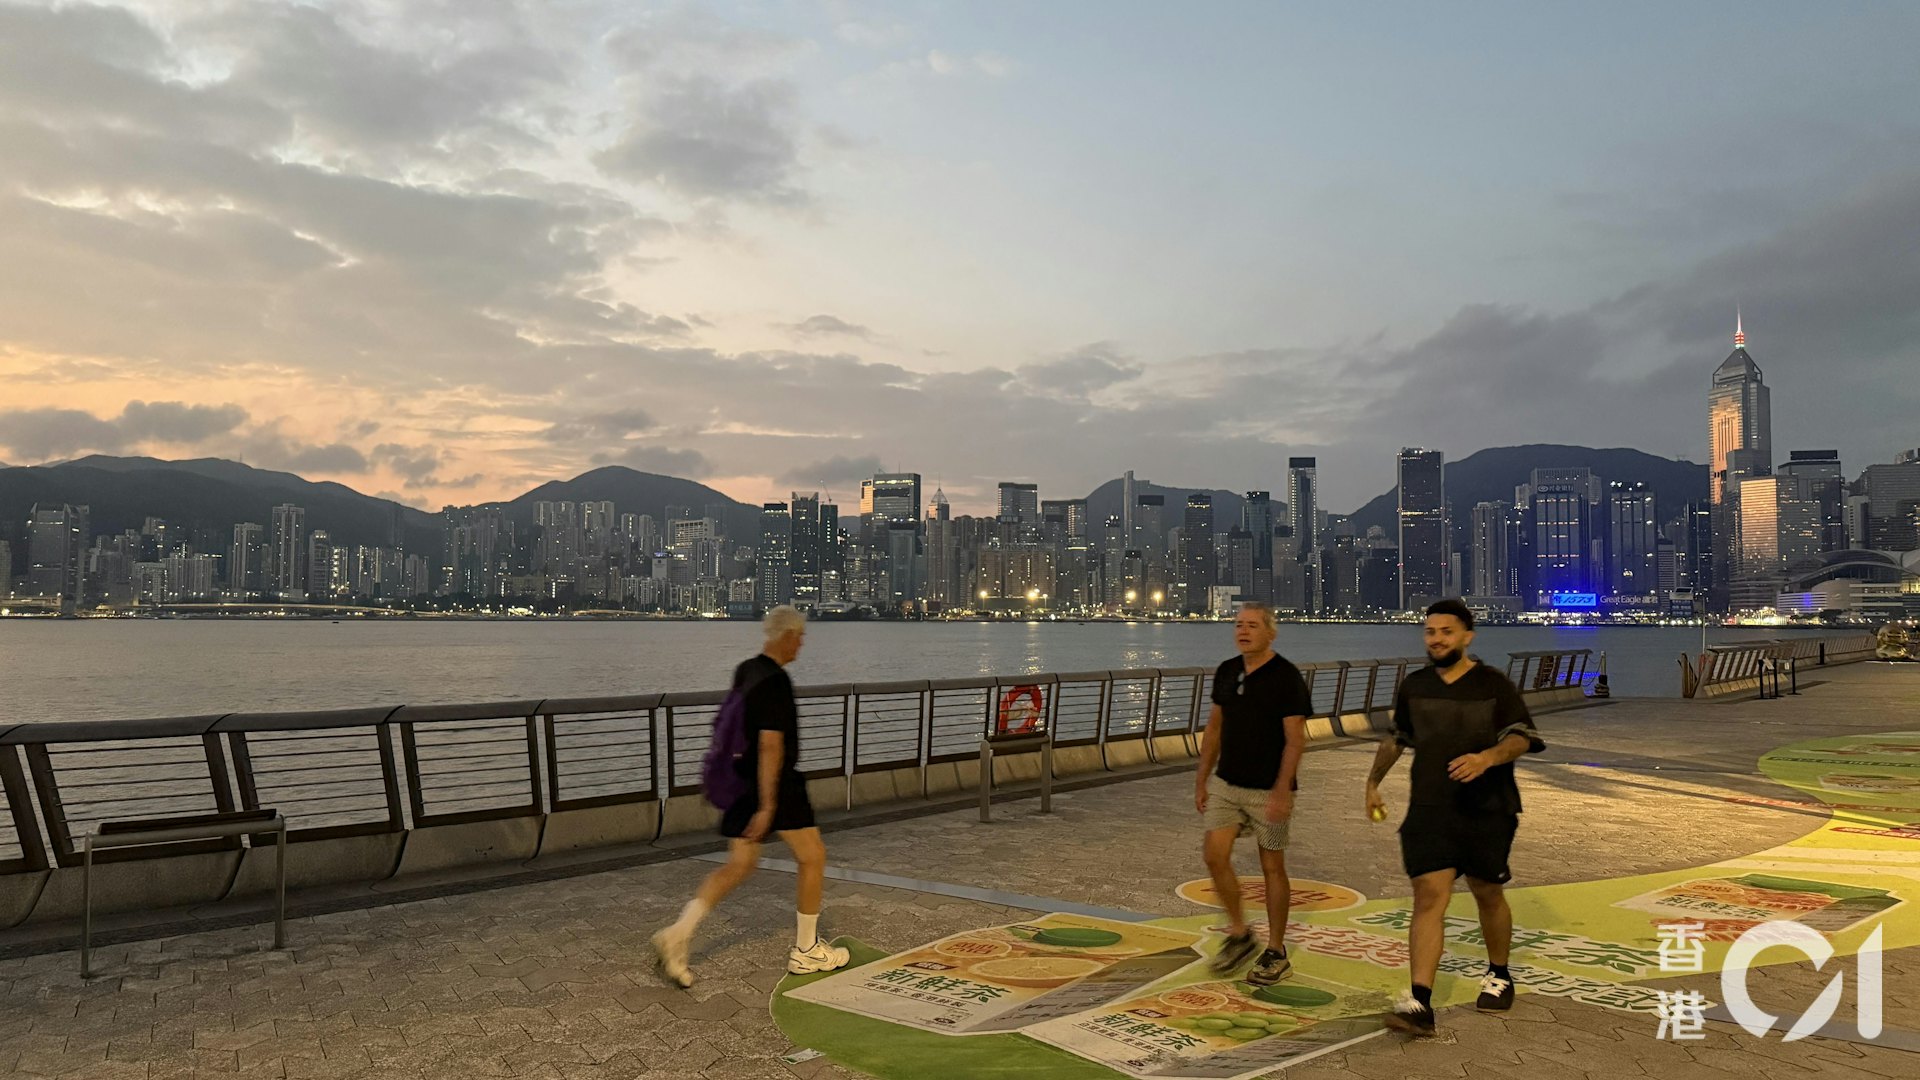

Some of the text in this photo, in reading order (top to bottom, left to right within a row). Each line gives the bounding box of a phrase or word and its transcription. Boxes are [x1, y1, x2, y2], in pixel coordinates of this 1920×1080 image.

[1600, 595, 1620, 603] Great
[1620, 595, 1641, 605] Eagle
[871, 968, 1012, 1003] 新鮮茶
[1093, 1013, 1207, 1051] 新鮮茶
